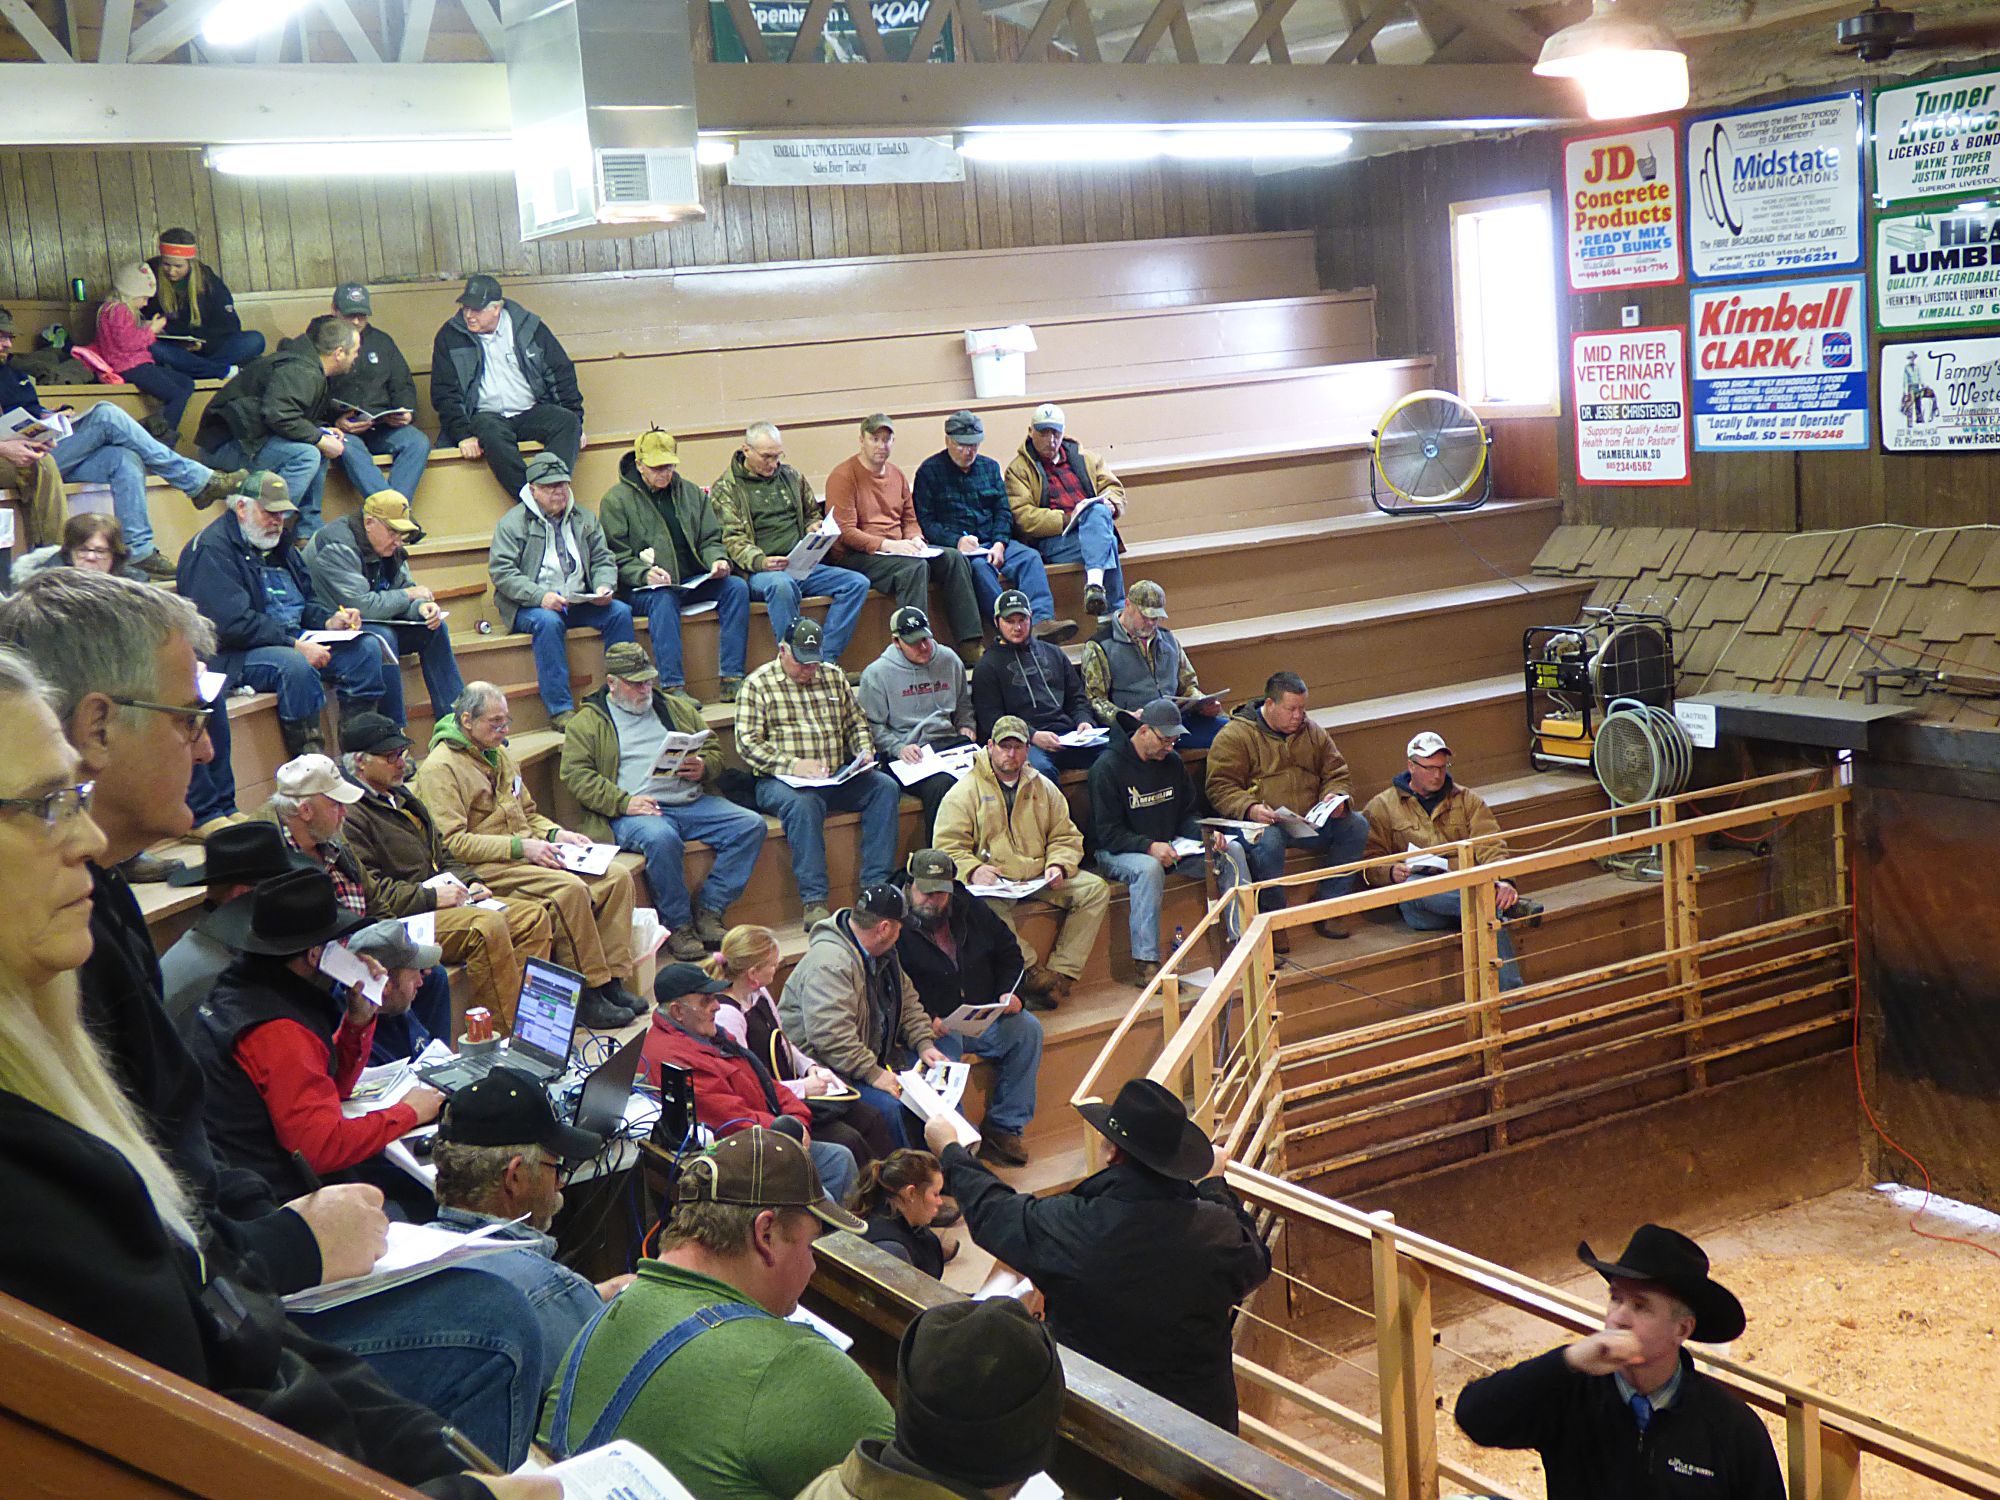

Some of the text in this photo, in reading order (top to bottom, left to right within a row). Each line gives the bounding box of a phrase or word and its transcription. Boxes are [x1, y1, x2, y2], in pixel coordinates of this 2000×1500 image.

[1915, 85, 1996, 117] Tupper
[1738, 128, 1770, 138] Customer
[1772, 123, 1807, 134] Experience
[1889, 141, 1945, 160] LICENSED
[1951, 139, 1959, 151] &
[1584, 144, 1635, 184] JD
[1734, 148, 1839, 181] Midstate
[1915, 151, 1991, 170] WAYNE TUPPER
[1733, 170, 1839, 194] COMMUNICATIONS
[1912, 164, 1990, 184] JUSTIN TUPPER
[1575, 182, 1670, 210] Concrete
[1918, 183, 1956, 192] SUPERIOR
[1575, 205, 1672, 232] Products
[1584, 226, 1666, 246] READY MIX
[1731, 234, 1774, 246] BROADBAND
[1778, 233, 1791, 241] that
[1808, 230, 1818, 239] NO
[1821, 226, 1846, 237] LIMITS!
[1581, 238, 1672, 258] FEED BUNKS
[1717, 246, 1826, 262] www.midstatesd.net
[1776, 251, 1838, 265] 778-6221
[1934, 270, 2000, 286] AFFORDABLE
[1924, 291, 1958, 303] LIVESTOCK
[1960, 288, 1997, 302] EQUIPMENT
[1698, 287, 1853, 336] Kimball
[1969, 305, 1983, 315] SD
[1584, 343, 1666, 362] MID RIVER
[1701, 337, 1802, 370] CLARK,
[1823, 344, 1852, 355] CLARK
[1577, 362, 1675, 382] VETERINARY
[1600, 383, 1651, 400] CLINIC
[1582, 403, 1678, 419] DR. JESSIE CHRISTENSEN
[1625, 425, 1650, 435] Quality
[1653, 424, 1679, 432] Animal
[1746, 416, 1776, 427] Owned
[1780, 415, 1796, 427] and
[1583, 438, 1603, 447] Health
[1605, 438, 1620, 447] from
[1623, 437, 1634, 446] Pet
[1637, 437, 1644, 446] to
[1762, 431, 1776, 439] SD
[1792, 430, 1844, 439] 778-6248
[1930, 436, 1940, 446] SD
